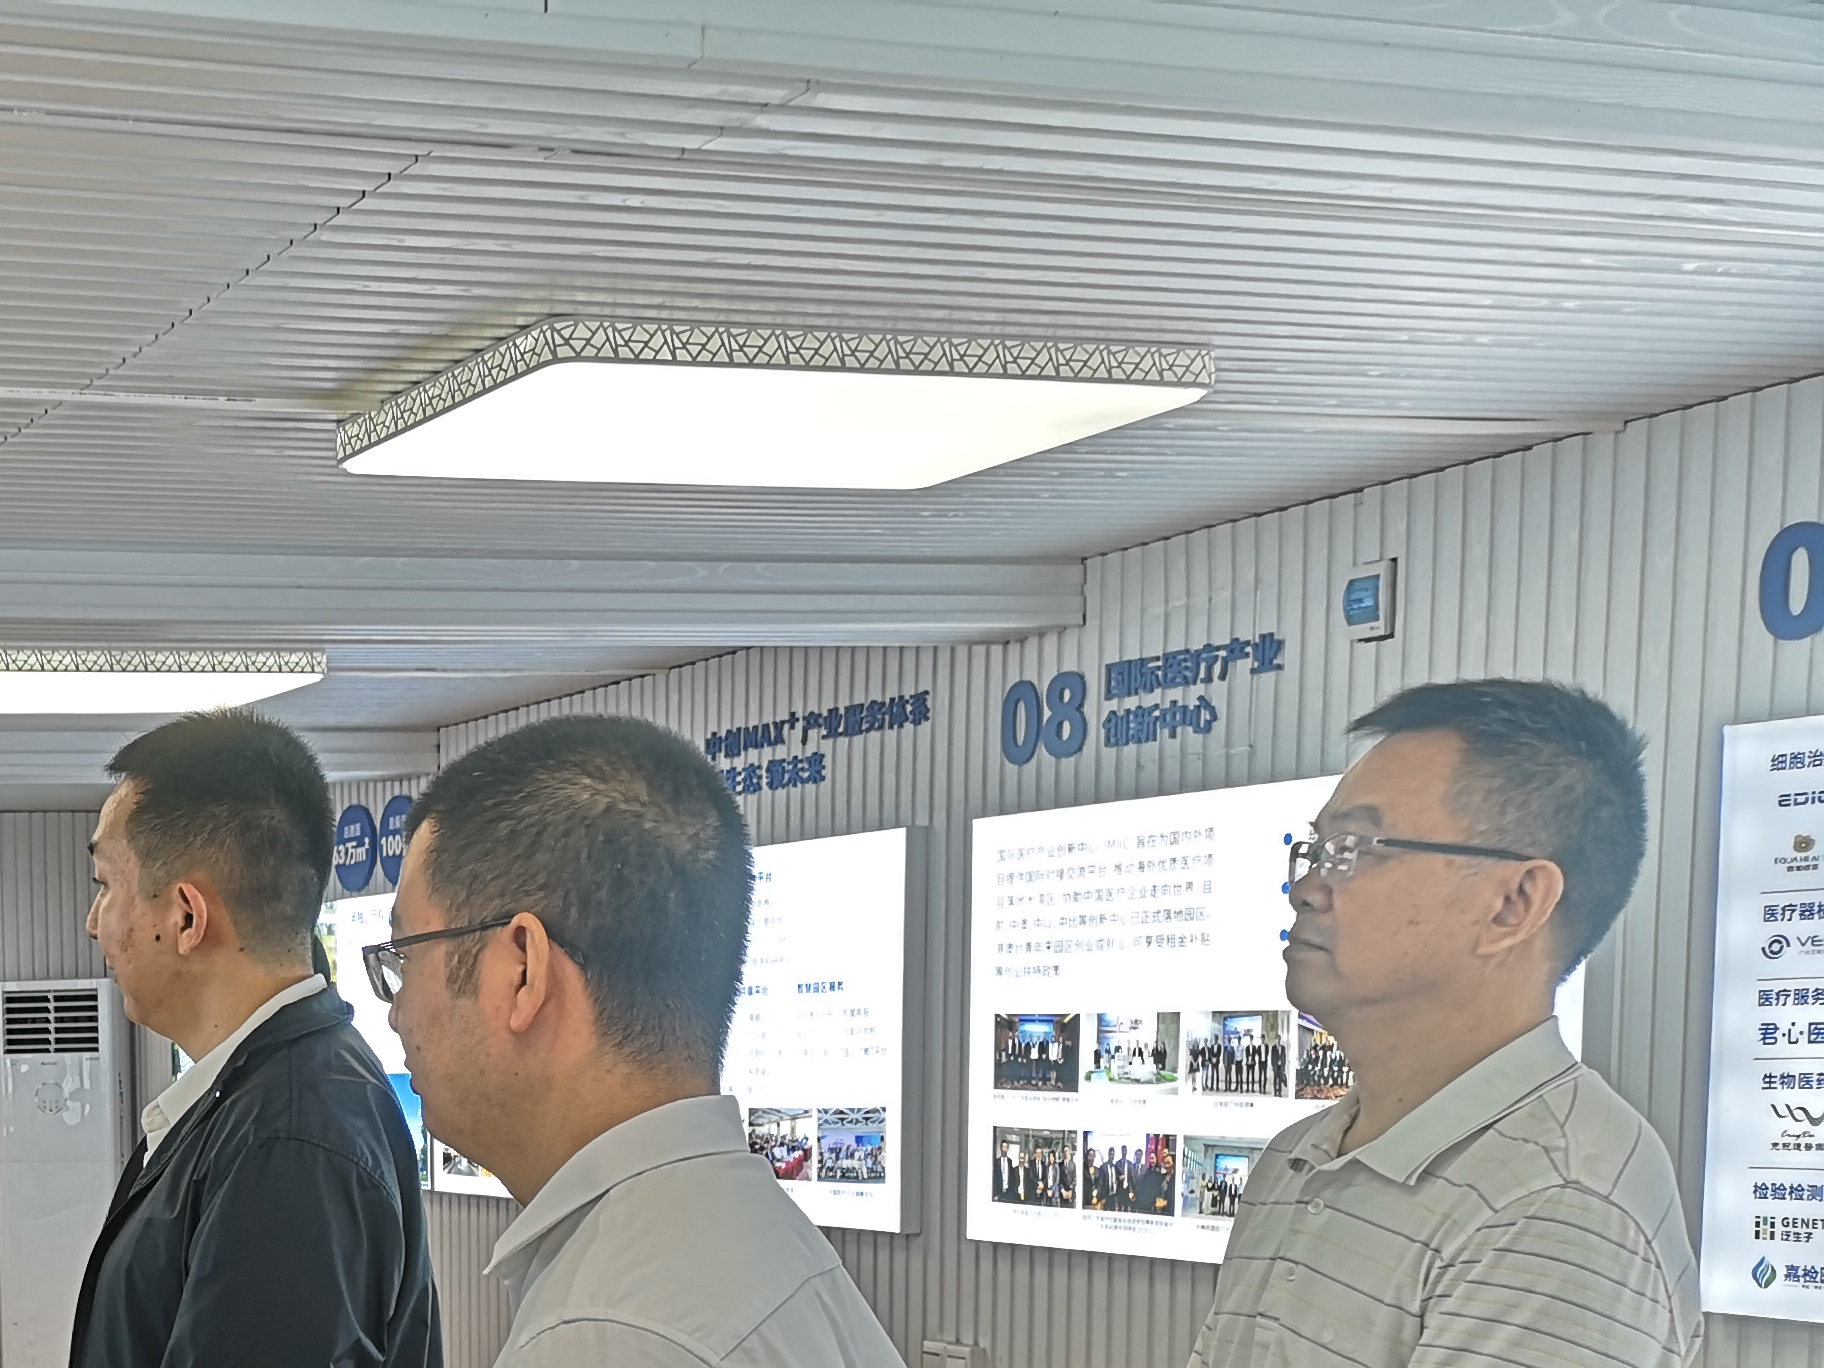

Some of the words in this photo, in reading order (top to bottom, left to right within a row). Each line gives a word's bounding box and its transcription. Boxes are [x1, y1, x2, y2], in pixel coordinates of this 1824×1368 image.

[1104, 633, 1285, 700] 国际医疗产业
[1001, 671, 1087, 765] 08
[1102, 695, 1218, 748] 创新中心
[1783, 1264, 1824, 1284] 嘉检
